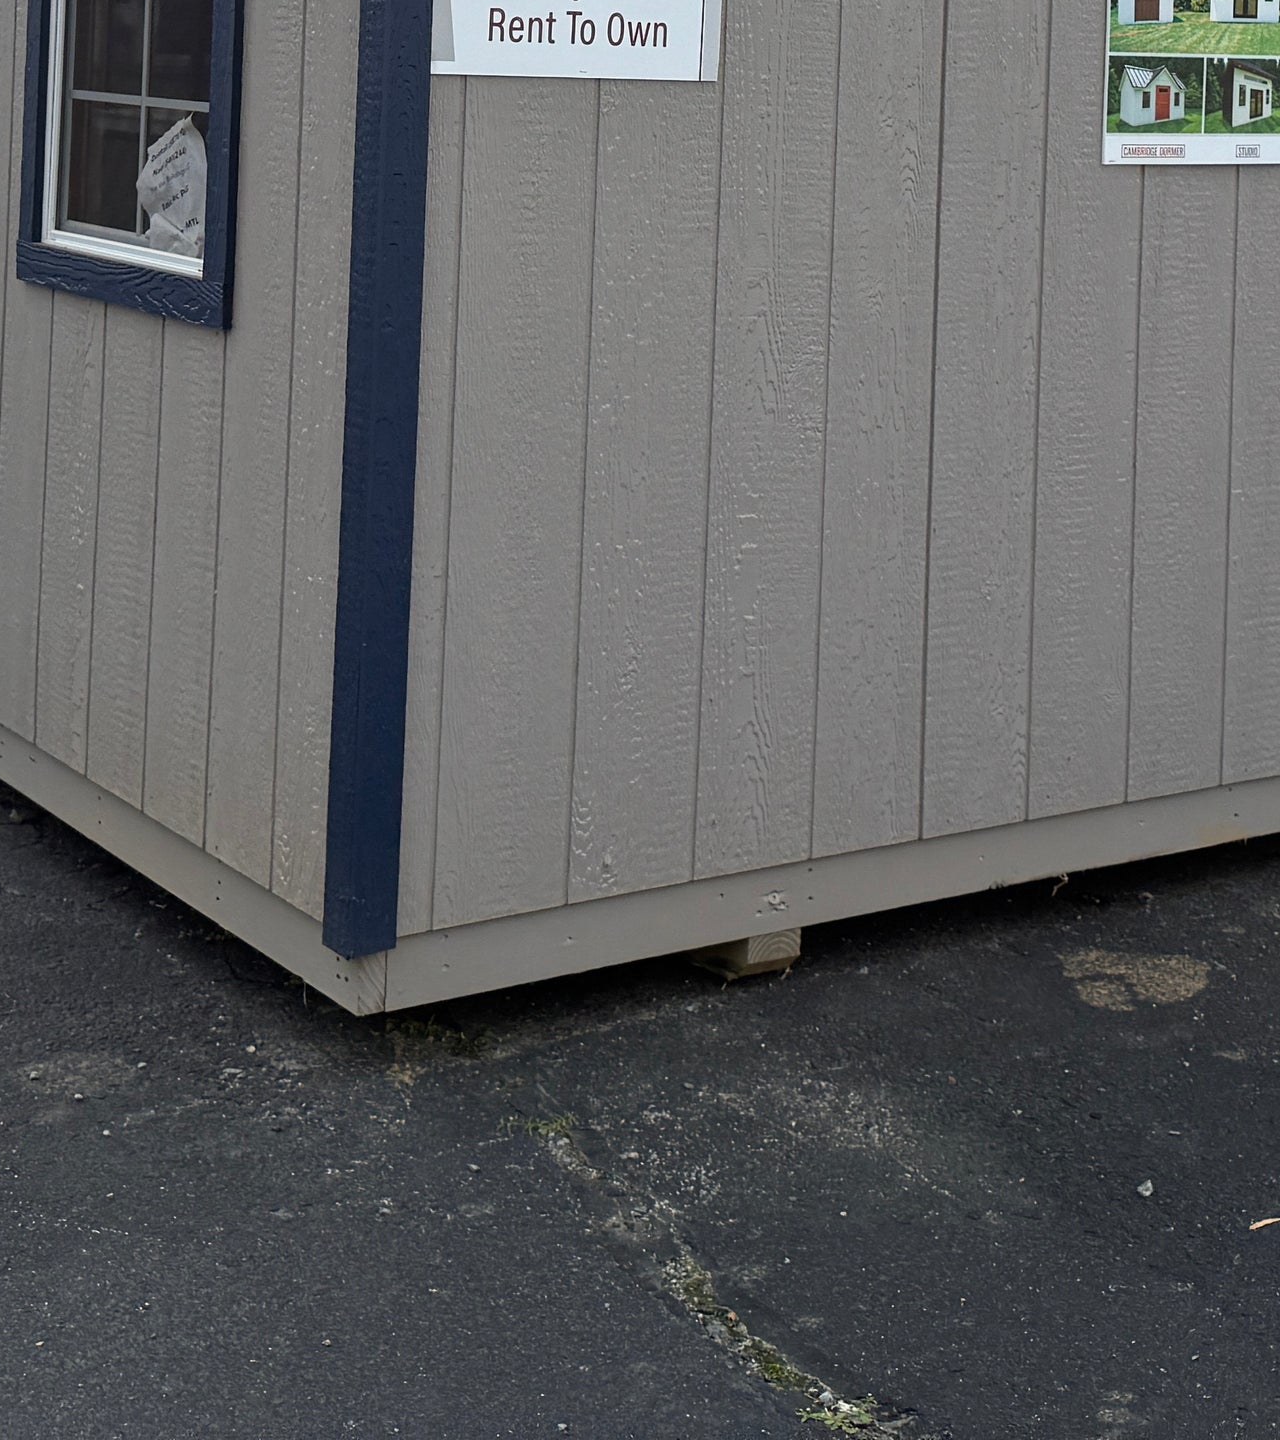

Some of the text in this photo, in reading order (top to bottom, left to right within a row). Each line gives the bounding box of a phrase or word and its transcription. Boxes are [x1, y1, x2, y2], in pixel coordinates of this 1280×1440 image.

[487, 7, 668, 48] Rent To Own
